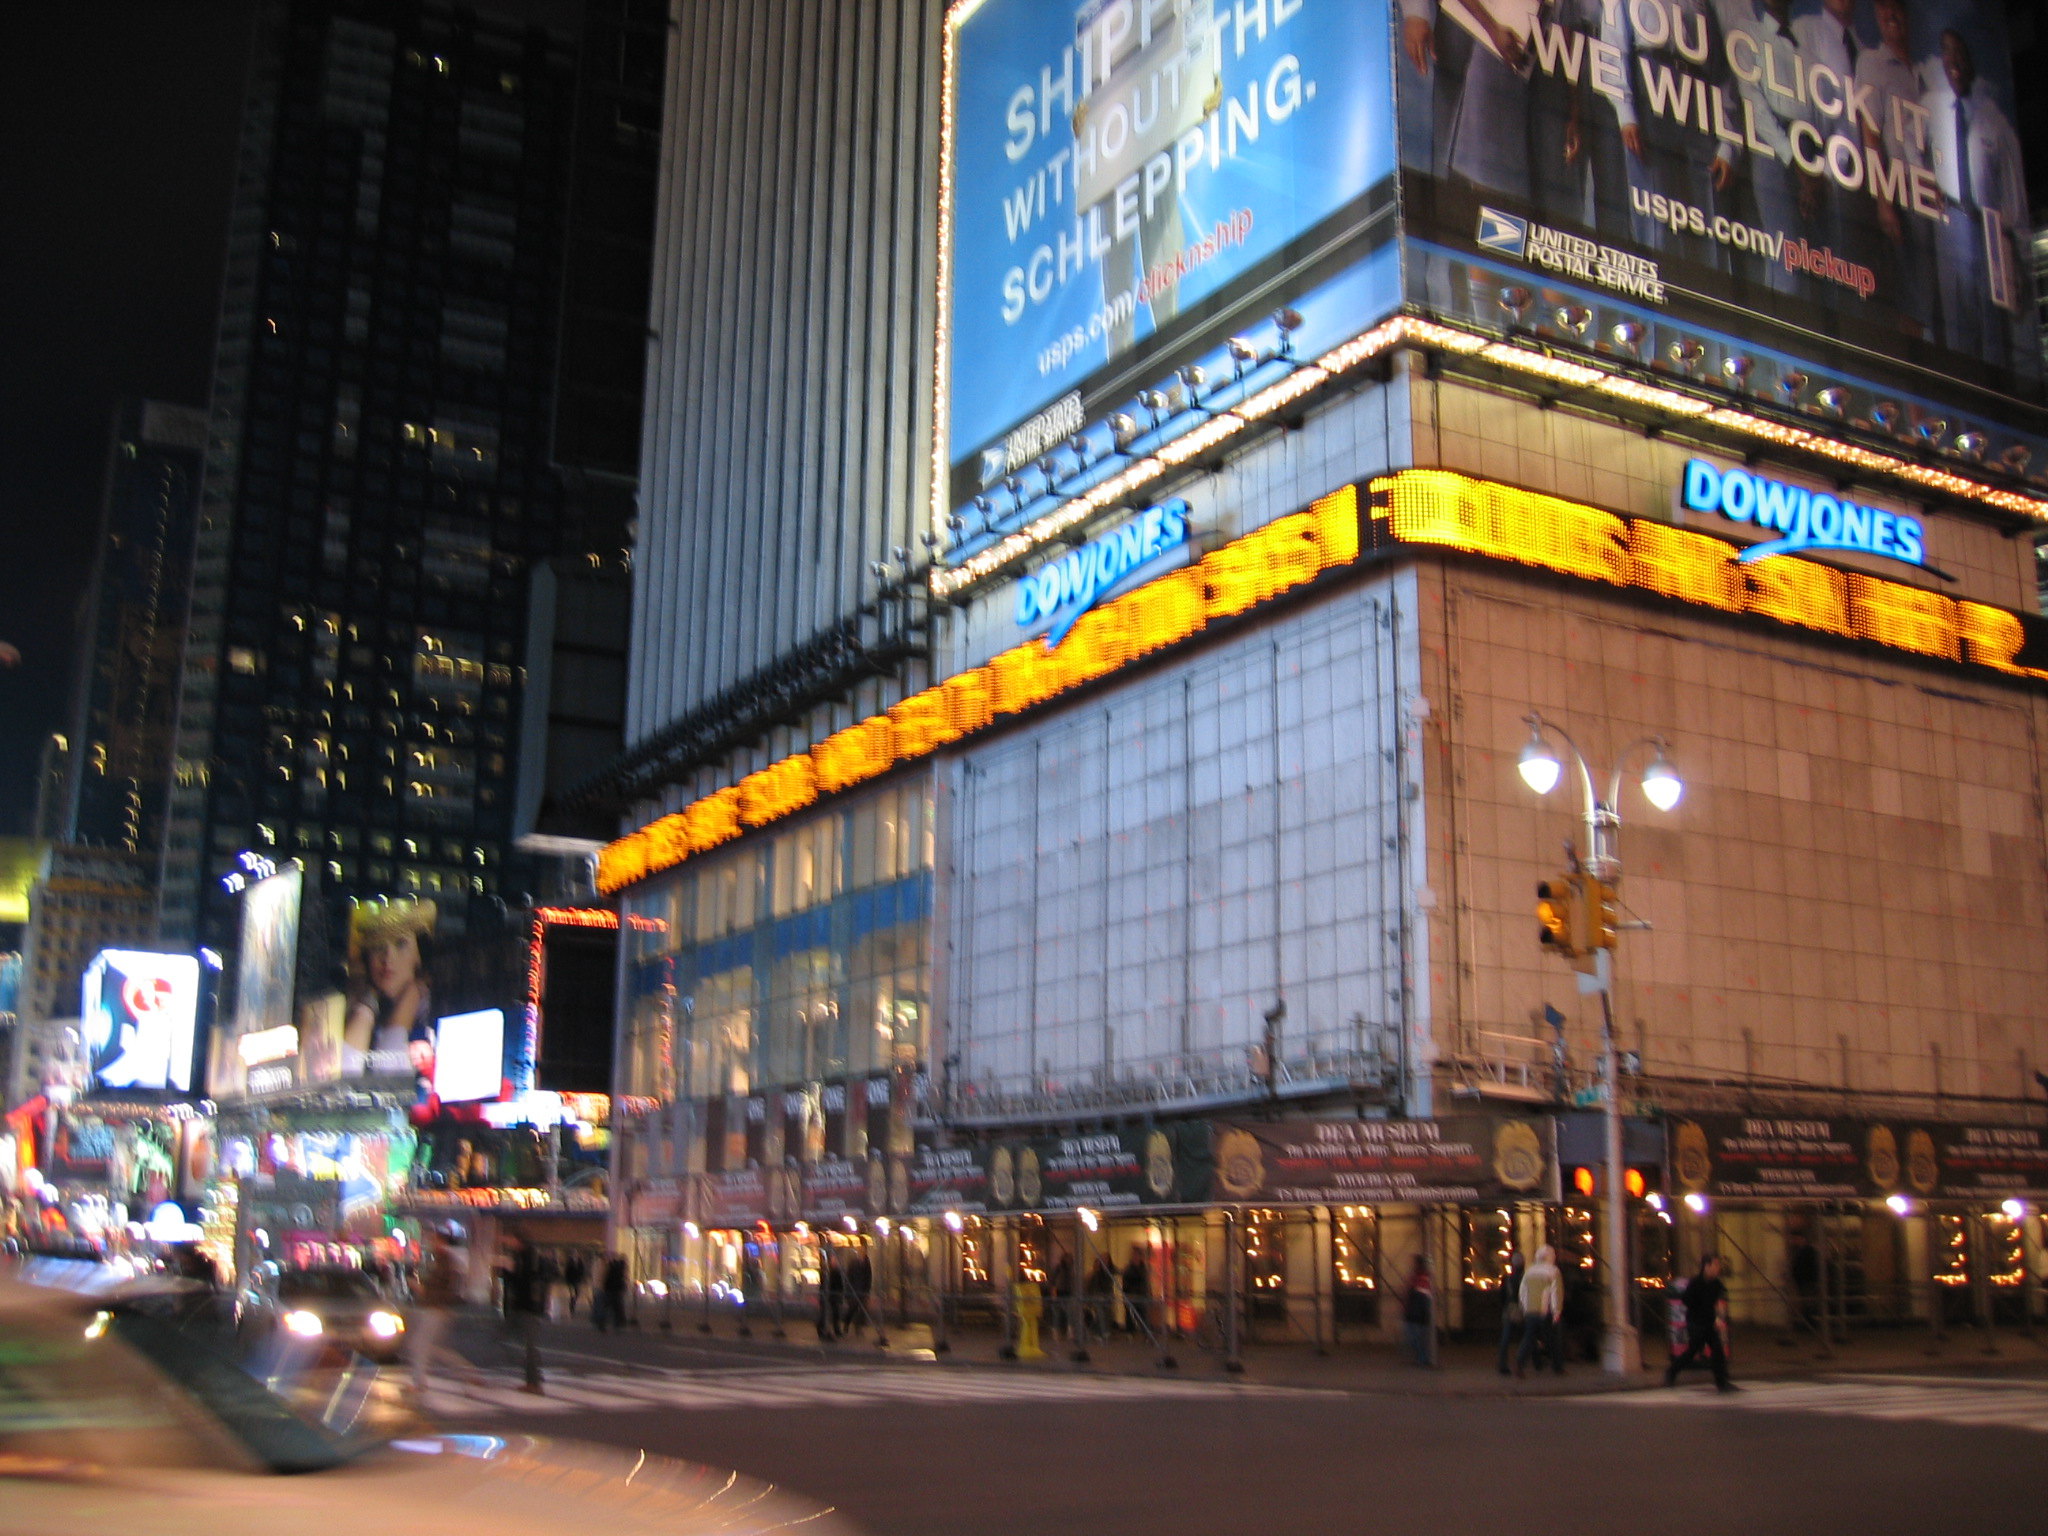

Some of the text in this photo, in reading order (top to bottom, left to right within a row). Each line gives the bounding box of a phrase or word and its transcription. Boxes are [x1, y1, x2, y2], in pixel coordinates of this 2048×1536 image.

[1528, 13, 1951, 226] WE WILL COME.
[1725, 28, 1881, 137] CLICK
[1002, 53, 1317, 327] SCHLEPPING.
[1003, 54, 1189, 244] WITHOUT
[1526, 241, 1596, 283] POSTAL
[1528, 221, 1660, 281] UNITED STATES
[1630, 184, 1877, 298] usps.com/pickup
